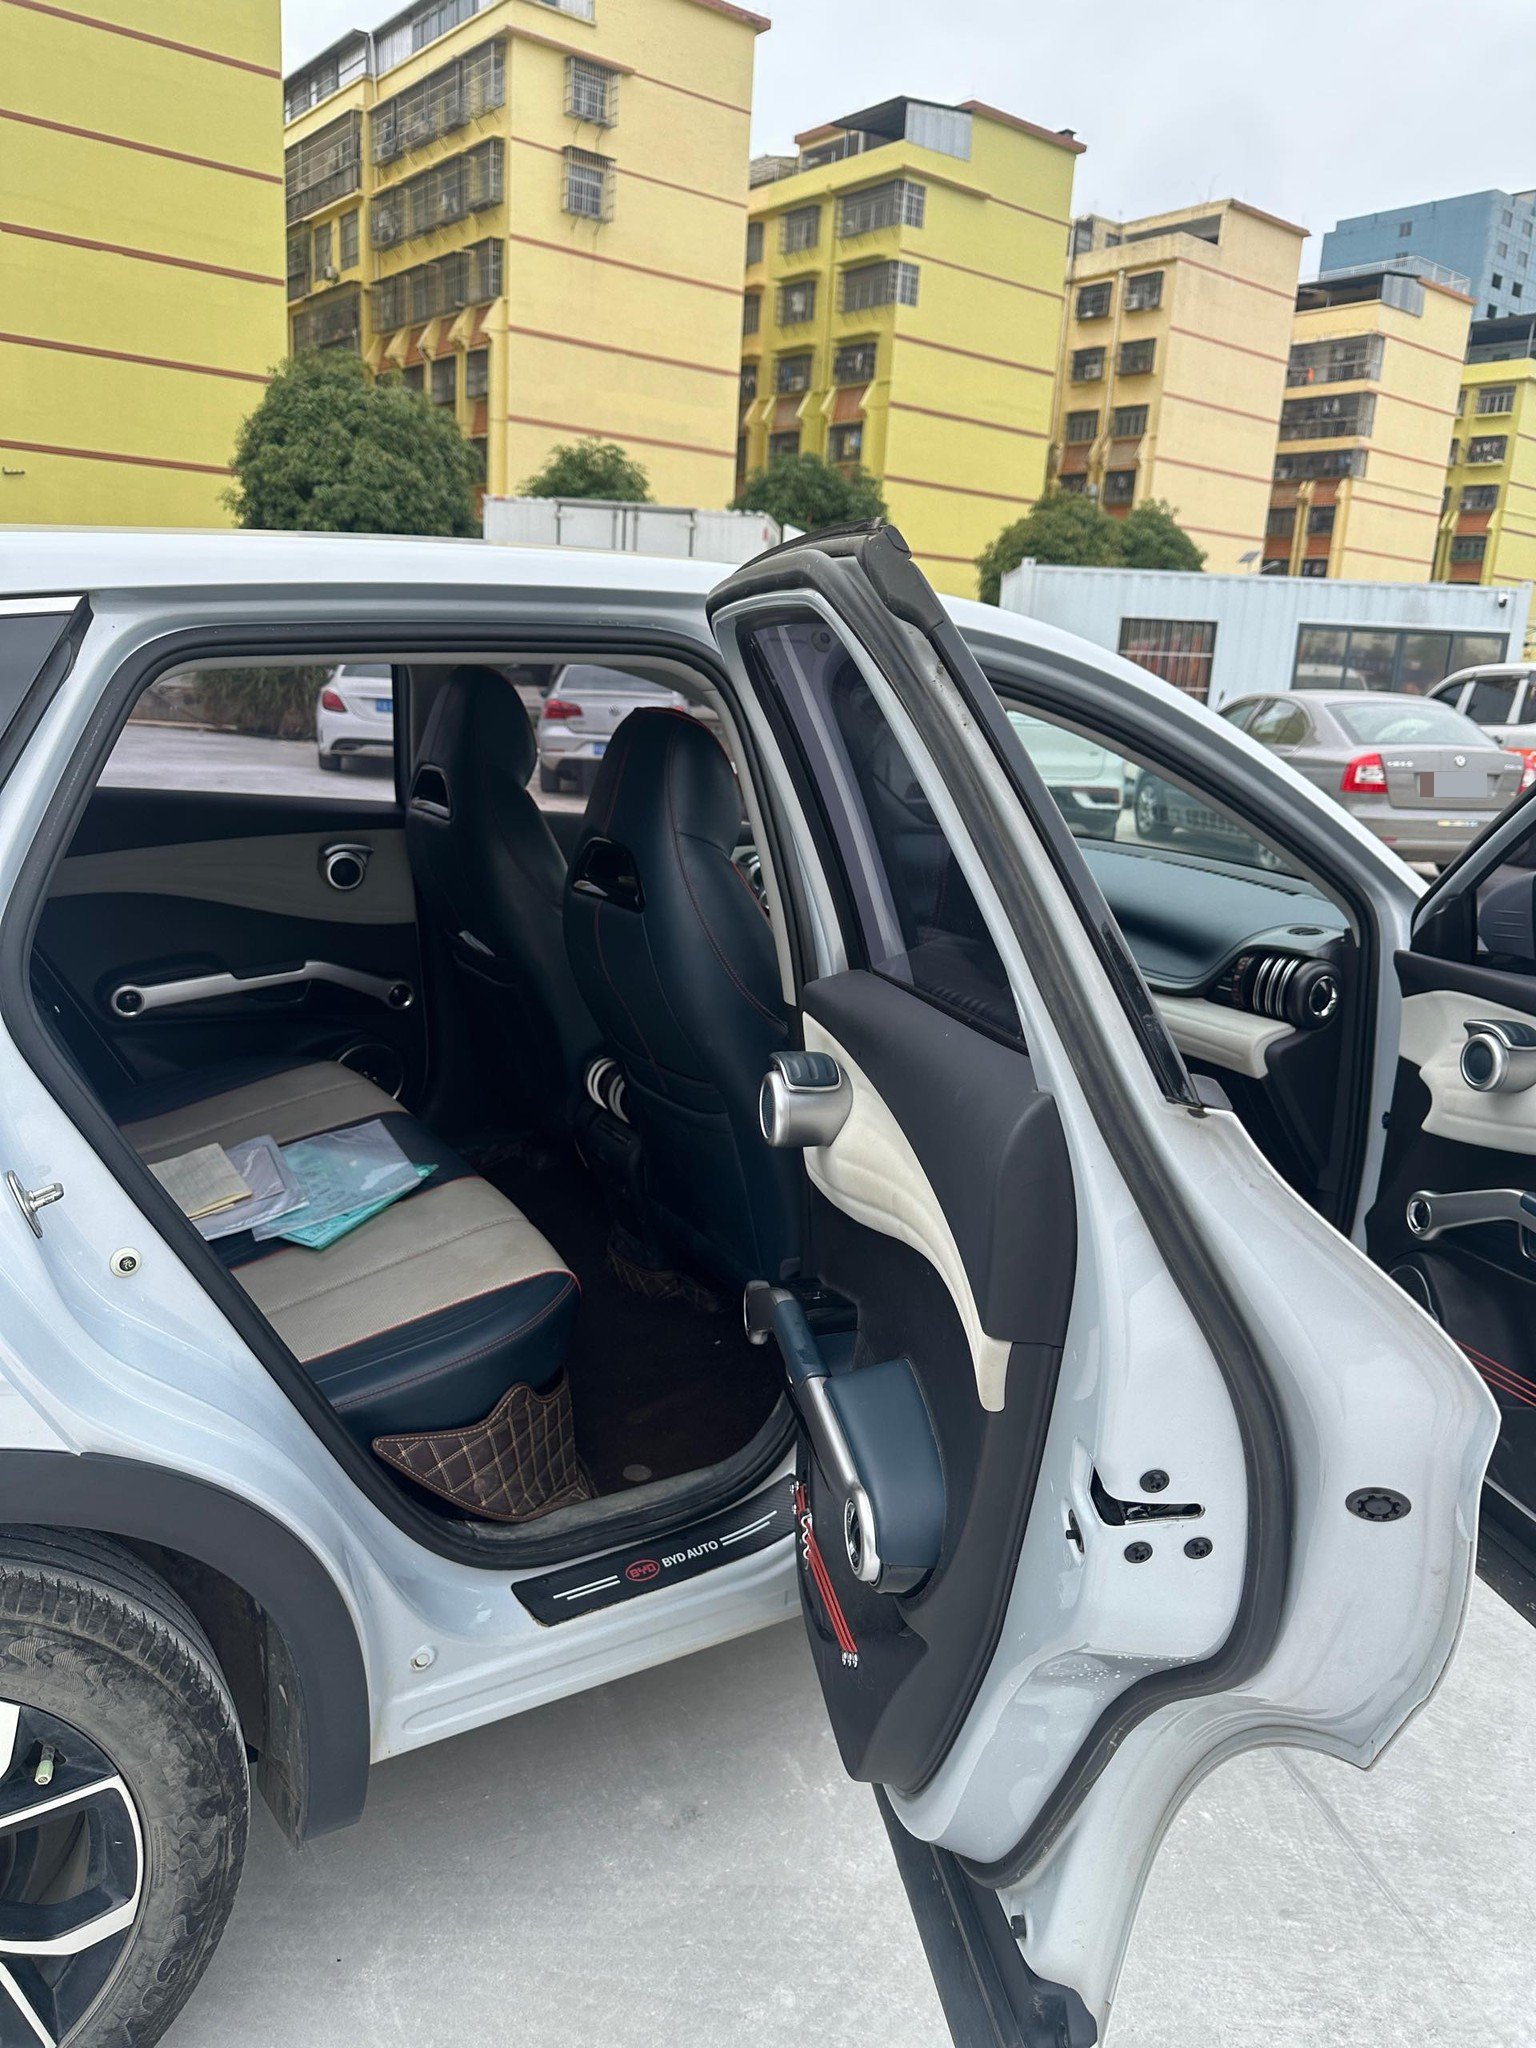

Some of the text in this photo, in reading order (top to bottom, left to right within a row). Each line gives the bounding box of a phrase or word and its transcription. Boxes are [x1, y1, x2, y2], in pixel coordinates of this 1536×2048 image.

[629, 1540, 719, 1579] BYD BYD AUTO
